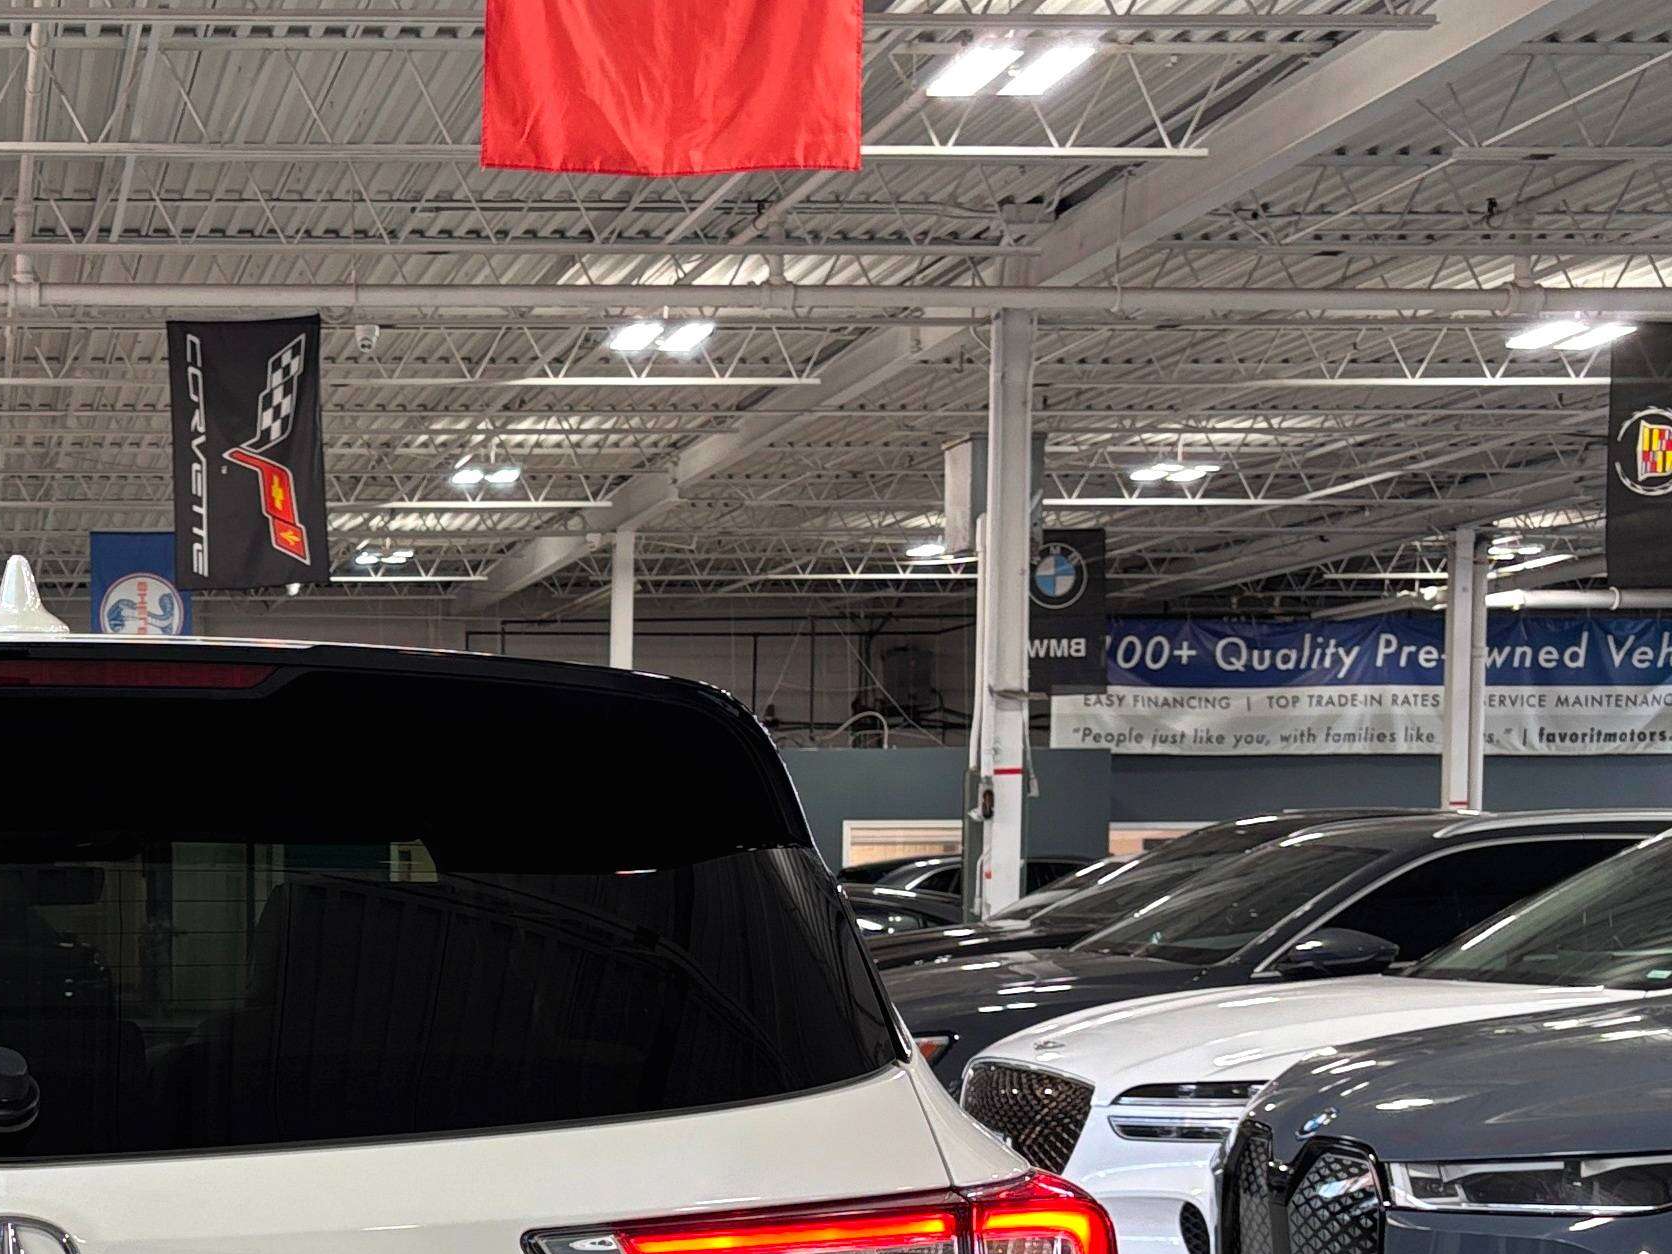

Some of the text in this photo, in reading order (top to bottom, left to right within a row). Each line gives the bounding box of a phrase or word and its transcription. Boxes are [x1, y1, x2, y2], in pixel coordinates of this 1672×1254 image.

[186, 334, 209, 577] CORVETTE
[1215, 633, 1360, 679] Quality
[1376, 631, 1589, 669] Pre-wned
[1083, 694, 1127, 708] EASY
[1132, 695, 1232, 710] FINANCING
[1266, 695, 1301, 710] TOP
[1307, 693, 1383, 709] TRADE-IN
[1391, 693, 1441, 708] RATES
[1483, 694, 1547, 708] ERVICE
[1152, 728, 1186, 748] just
[1193, 727, 1226, 745] like
[1233, 732, 1271, 748] you,
[1280, 726, 1317, 744] with
[1325, 726, 1397, 744] families
[1404, 726, 1435, 744] like
